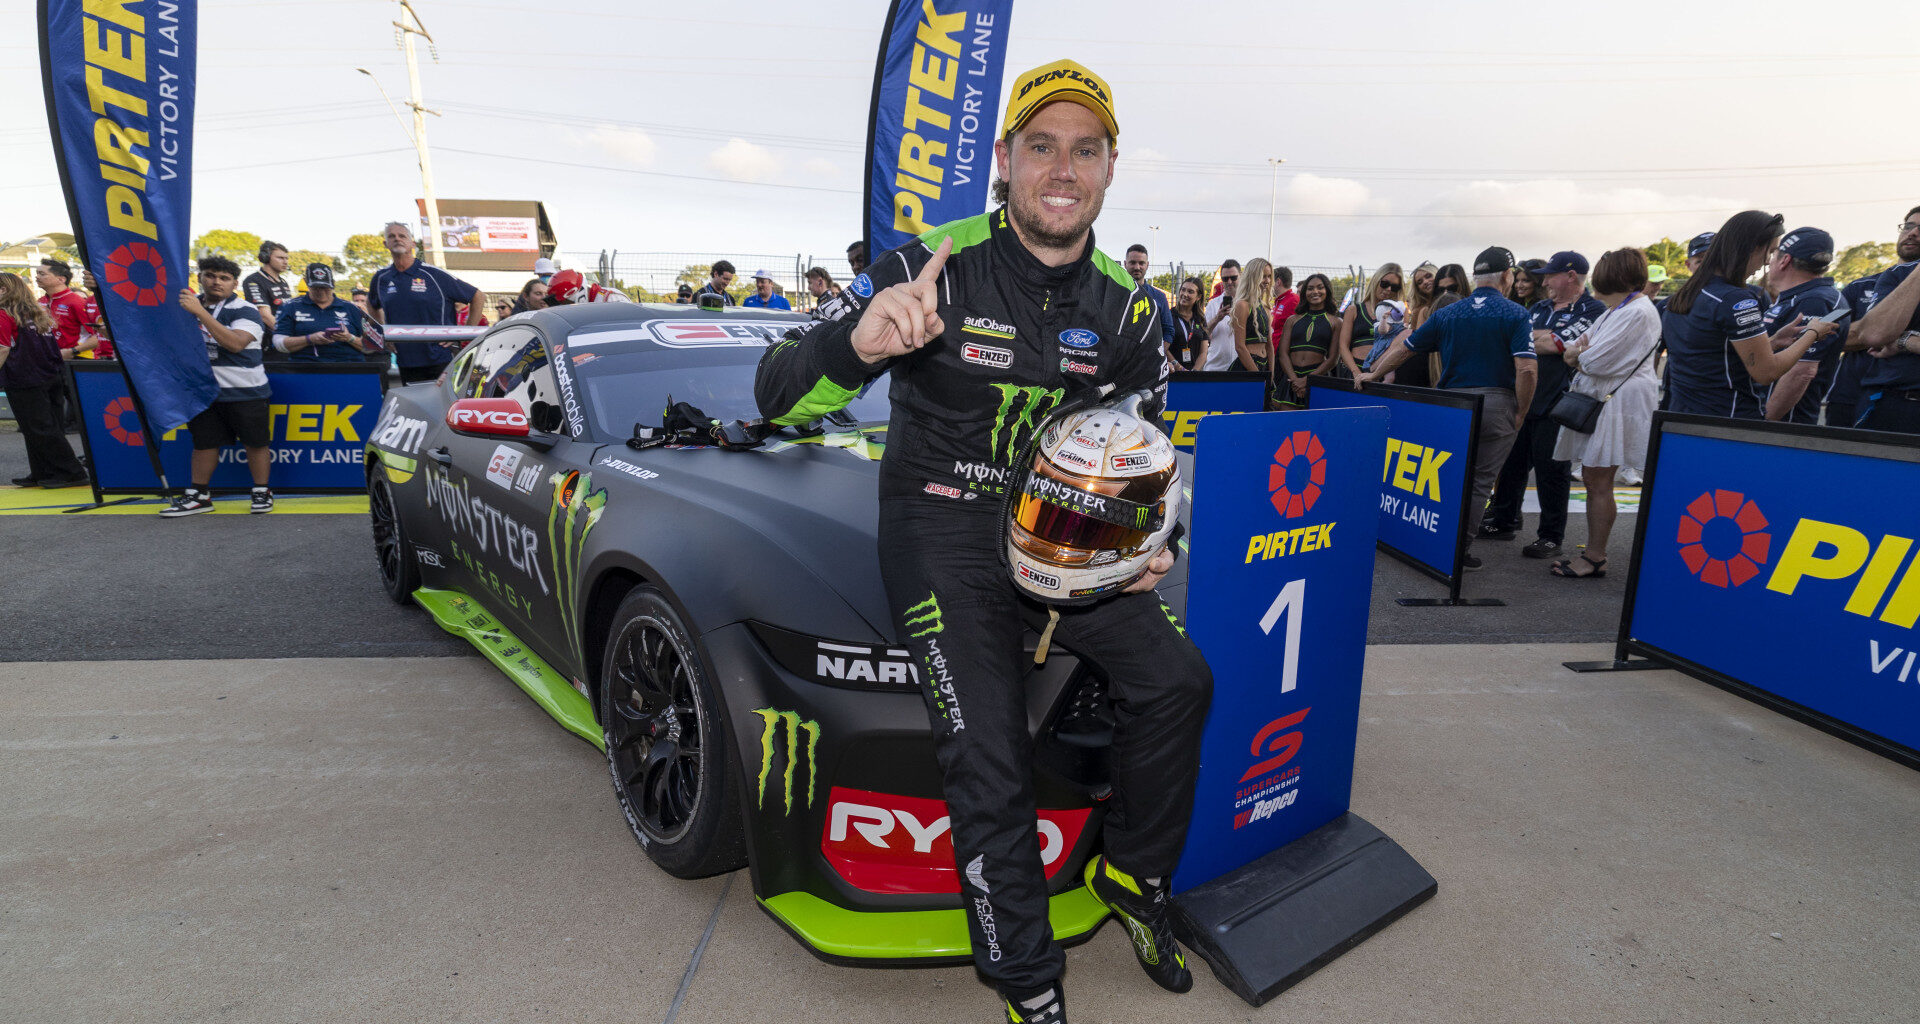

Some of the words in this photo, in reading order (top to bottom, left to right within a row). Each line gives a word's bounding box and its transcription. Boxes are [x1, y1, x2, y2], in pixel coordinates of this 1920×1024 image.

[158, 0, 179, 58] LAN
[952, 84, 983, 186] VICTORY
[968, 13, 994, 76] LANE
[1017, 69, 1109, 103] DUNLOP
[159, 65, 179, 181] VICTORY
[893, 0, 967, 236] PIRTEK
[720, 325, 797, 338] ENZ
[1067, 331, 1093, 345] Ford
[979, 350, 1009, 364] ENZED
[1059, 346, 1099, 357] RACING
[1067, 360, 1098, 375] Castrol
[453, 409, 528, 427] RYCO
[218, 449, 303, 463] VICRY
[310, 449, 364, 463] LANE
[1076, 437, 1096, 447] BELL
[606, 459, 660, 480] DUNLOP
[1125, 456, 1149, 467] ENZED
[1029, 475, 1106, 512] MONSTER
[1034, 491, 1091, 515] ENERGY
[1402, 501, 1440, 533] LANE
[1244, 522, 1337, 565] PIRTEK
[450, 540, 533, 620] ENERGY
[1028, 570, 1057, 587] ENZED
[1258, 578, 1306, 694] 1
[817, 654, 920, 684] NAR
[1869, 639, 1920, 685] VI
[924, 655, 948, 719] ENERGY
[928, 638, 966, 734] MONSTER
[1235, 775, 1300, 808] CHAMPIONSHIP
[1236, 766, 1301, 800] SUPERCARS
[1248, 788, 1299, 824] Repco
[973, 897, 988, 934] RACING
